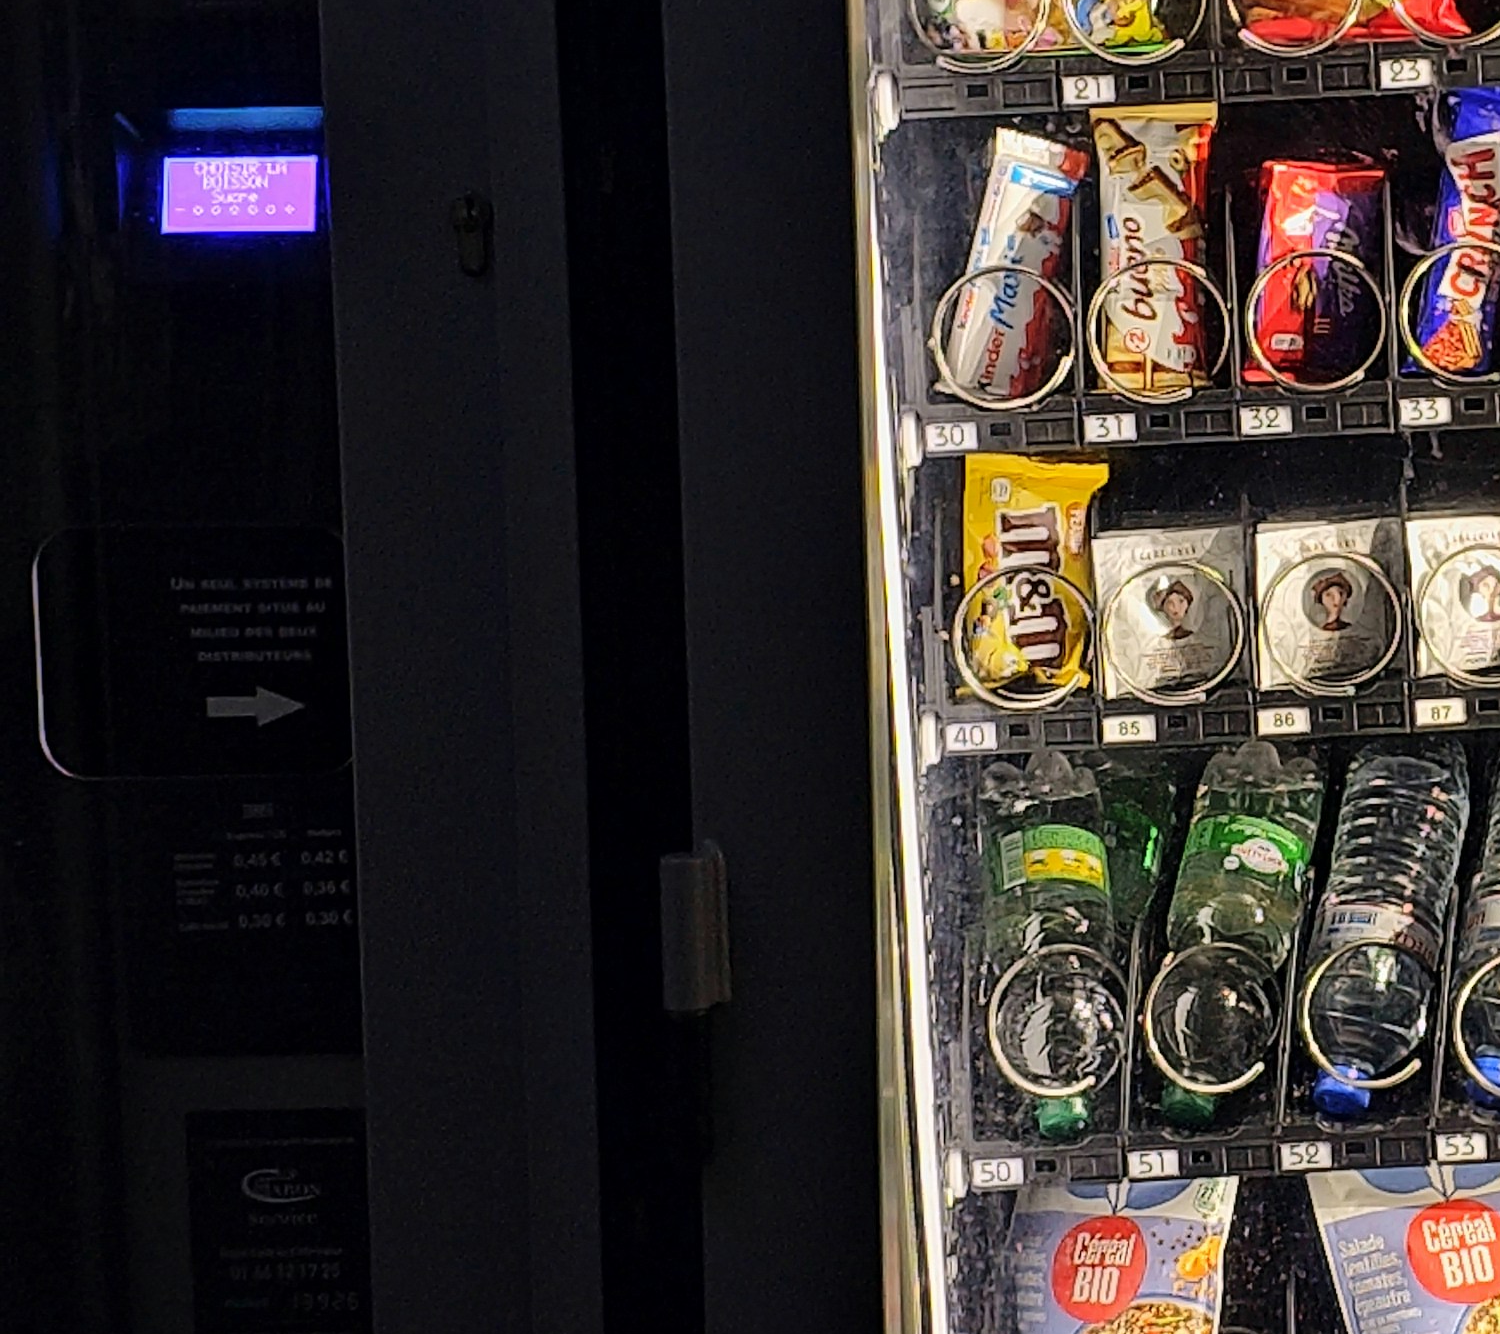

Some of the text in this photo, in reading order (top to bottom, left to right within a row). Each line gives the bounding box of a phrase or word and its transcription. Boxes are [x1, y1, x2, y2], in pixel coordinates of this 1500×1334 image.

[1389, 59, 1421, 82] 23
[1073, 78, 1105, 99] 21
[1449, 147, 1498, 299] CRUNCH
[1121, 217, 1158, 321] bueno
[1250, 407, 1282, 430] 32
[1408, 398, 1440, 421] 33
[934, 425, 965, 446] 30
[1097, 417, 1124, 438] 31
[1272, 713, 1296, 729] 86
[1430, 704, 1453, 721] 87
[953, 726, 985, 748] 40
[1117, 715, 1141, 736] 85
[1287, 1144, 1320, 1167] 52
[1444, 1135, 1476, 1157] 53
[980, 1161, 1011, 1184] 50
[1139, 1152, 1167, 1175] 51
[1439, 1246, 1495, 1290] BIO
[1073, 1266, 1121, 1305] BIO
